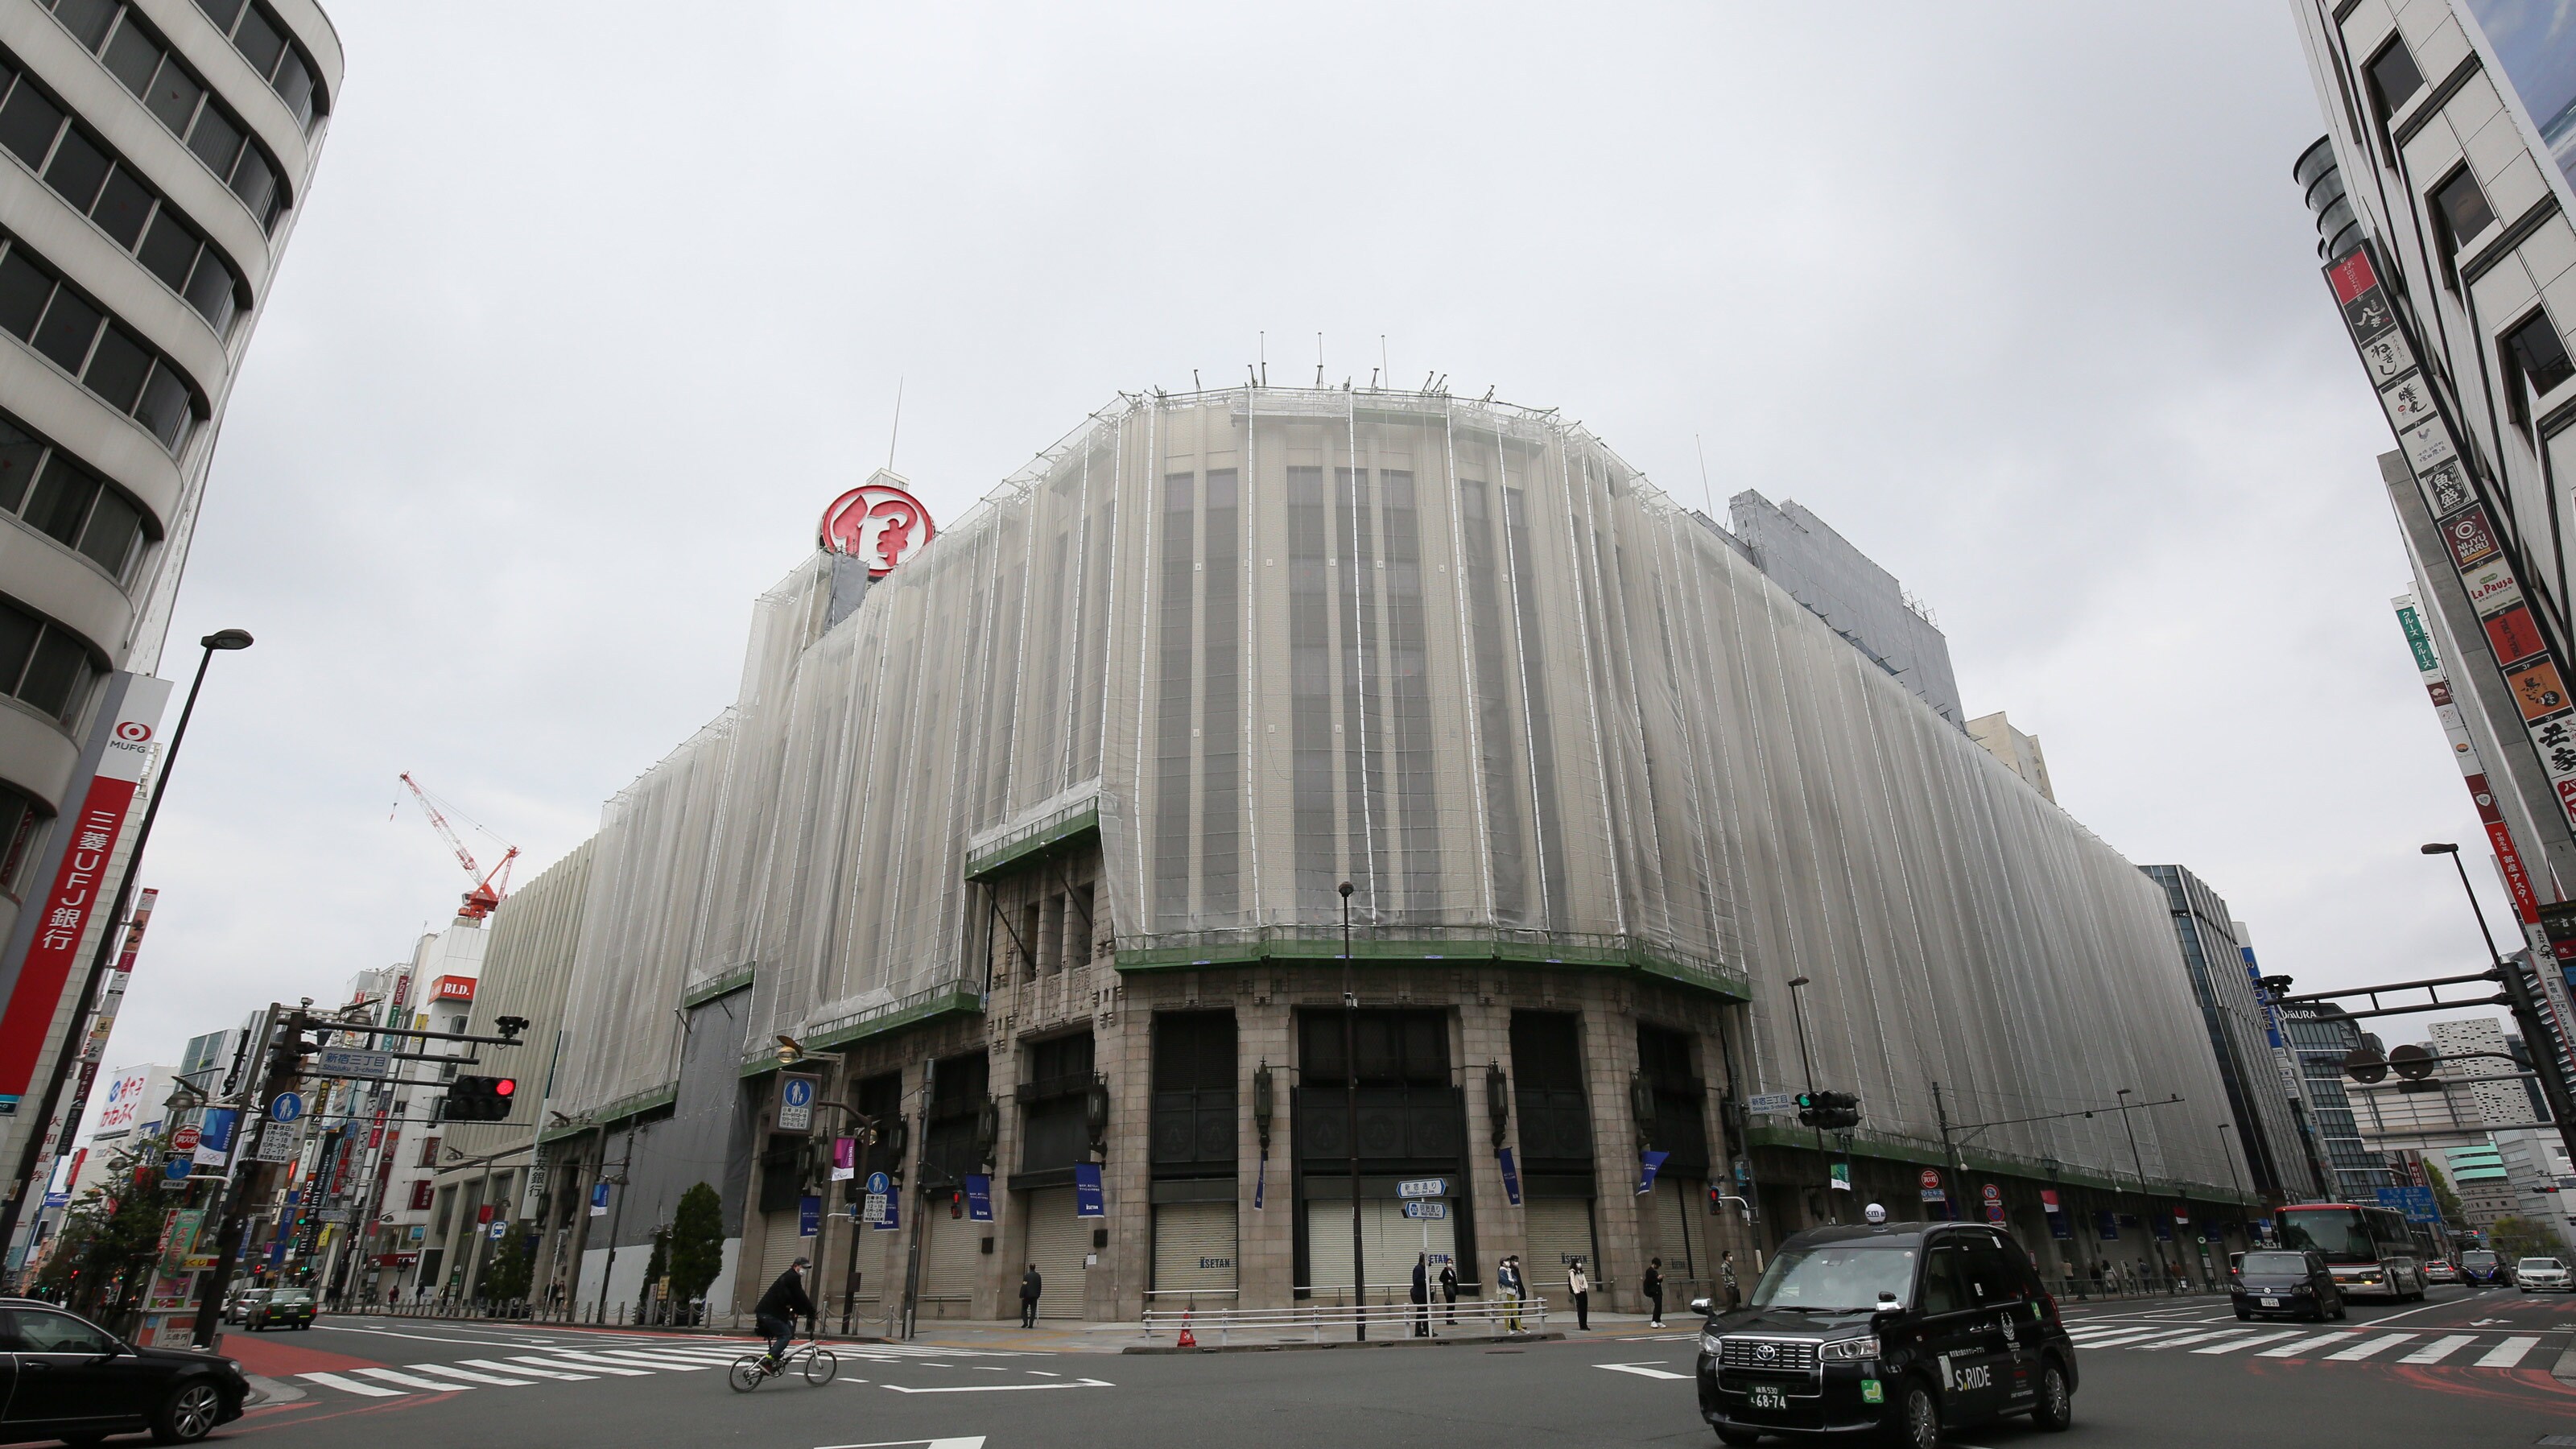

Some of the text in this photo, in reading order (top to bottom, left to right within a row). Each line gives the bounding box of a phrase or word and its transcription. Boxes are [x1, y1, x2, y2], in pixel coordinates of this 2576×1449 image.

[2371, 343, 2396, 375] ねぎし
[2434, 473, 2461, 509] 魚盛
[2459, 540, 2490, 559] MARU
[2471, 576, 2514, 601] La Pausa
[2402, 610, 2419, 637] クルーズ
[2415, 642, 2432, 667] クルーズ
[109, 740, 147, 754] MUFG
[42, 810, 117, 951] 三菱UFJ銀行
[2503, 855, 2529, 906] 銀座アスター
[444, 982, 470, 996] BLD.
[322, 1063, 384, 1074] Shinjuku 3-chome
[324, 1052, 386, 1067] 新宿三丁目
[1752, 1094, 1788, 1106] 新宿三丁目
[100, 1102, 138, 1128] かねふく
[175, 1135, 198, 1144] 消火栓
[528, 1146, 548, 1198] 住友銀行
[303, 1180, 315, 1199] ガスト
[1405, 1182, 1437, 1191] 新宿通り
[1419, 1204, 1441, 1213] 明治通り
[1199, 1257, 1230, 1269] ISETAN
[1955, 1364, 1992, 1392] S.RIDE
[1757, 1394, 1786, 1409] 68-74
